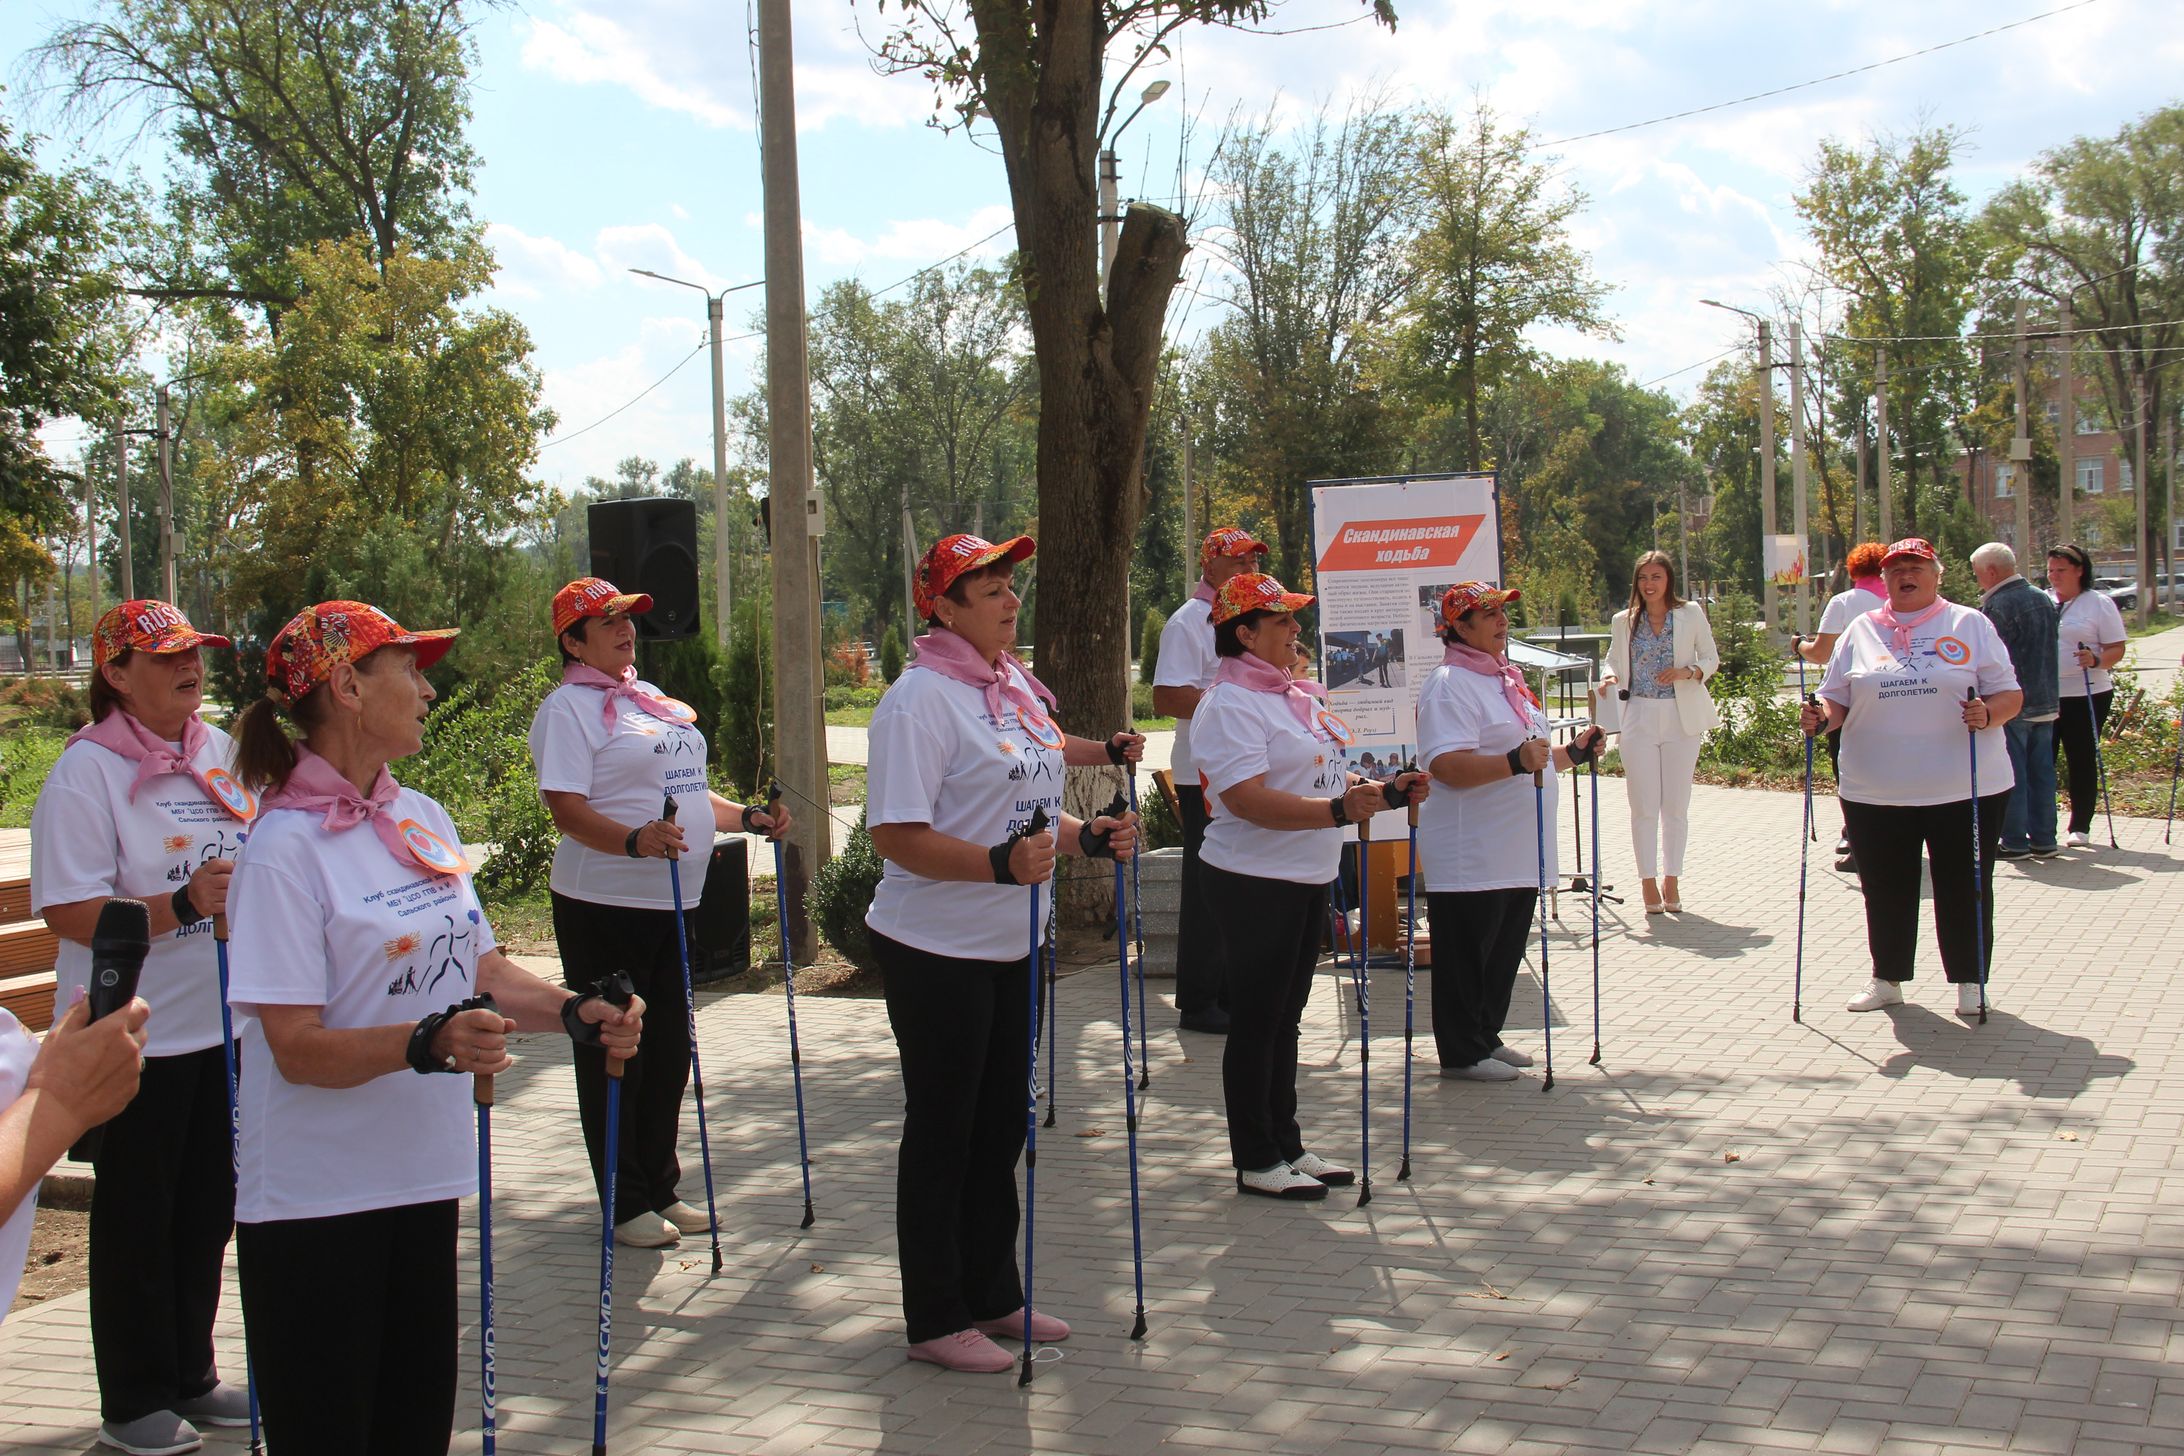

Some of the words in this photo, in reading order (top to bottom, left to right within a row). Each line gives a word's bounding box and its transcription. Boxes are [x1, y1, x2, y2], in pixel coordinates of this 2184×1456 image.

[1343, 525, 1460, 544] Скандинавская
[1376, 546, 1430, 564] ходьба
[1880, 678, 1918, 688] ШАГАЕМ
[1878, 687, 1938, 699] ДОЛГОЛЕТИЮ
[664, 768, 696, 780] ШАГАЕМ
[156, 800, 172, 808] Клуб
[362, 890, 384, 904] Клуб
[398, 902, 432, 917] Сальского
[600, 1290, 612, 1351] CMD
[485, 1327, 496, 1390] CMD
